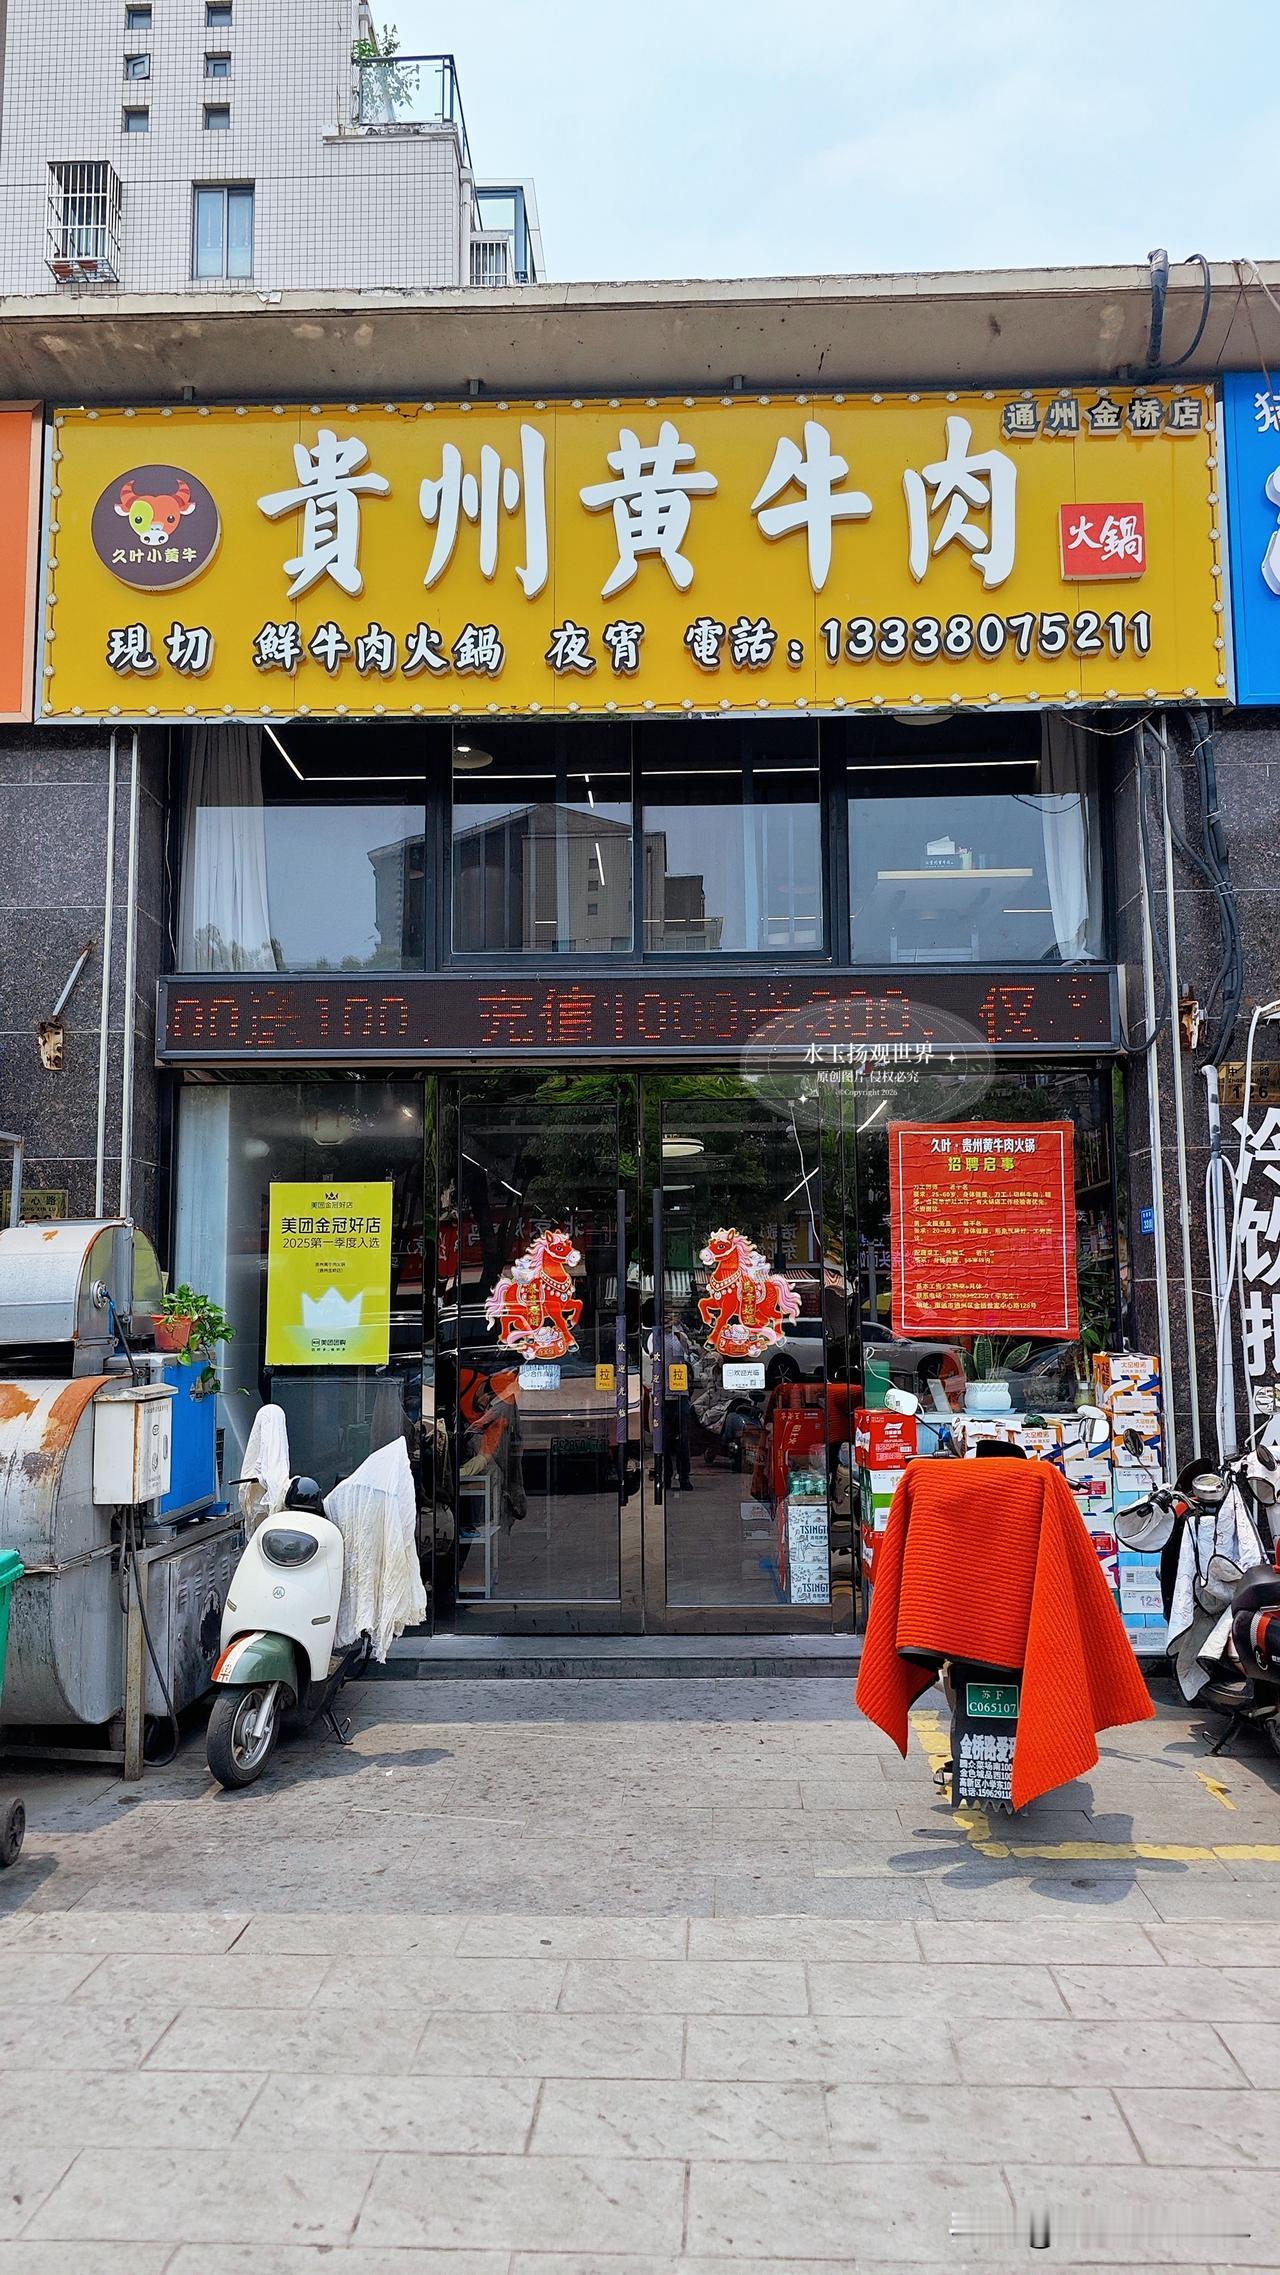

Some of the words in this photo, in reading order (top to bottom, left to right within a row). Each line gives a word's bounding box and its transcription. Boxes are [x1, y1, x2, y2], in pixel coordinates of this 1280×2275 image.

[1004, 398, 1201, 432] 通州金桥店
[1067, 514, 1144, 564] 火鍋
[111, 547, 197, 565] 久叶小黄牛
[107, 622, 213, 674] 現切
[253, 621, 504, 676] 鮮牛肉火鍋
[550, 620, 640, 673] 夜宵
[821, 611, 1152, 664] 13338075211
[948, 1157, 1015, 1172] 招聘启事
[311, 1201, 353, 1209] 美团金冠好店
[281, 1217, 381, 1234] 美团金冠好店
[283, 1237, 380, 1249] 2025第一季度入选
[600, 1368, 611, 1380] 拉
[673, 1368, 684, 1380] 拉
[969, 1702, 1017, 1713] C065107
